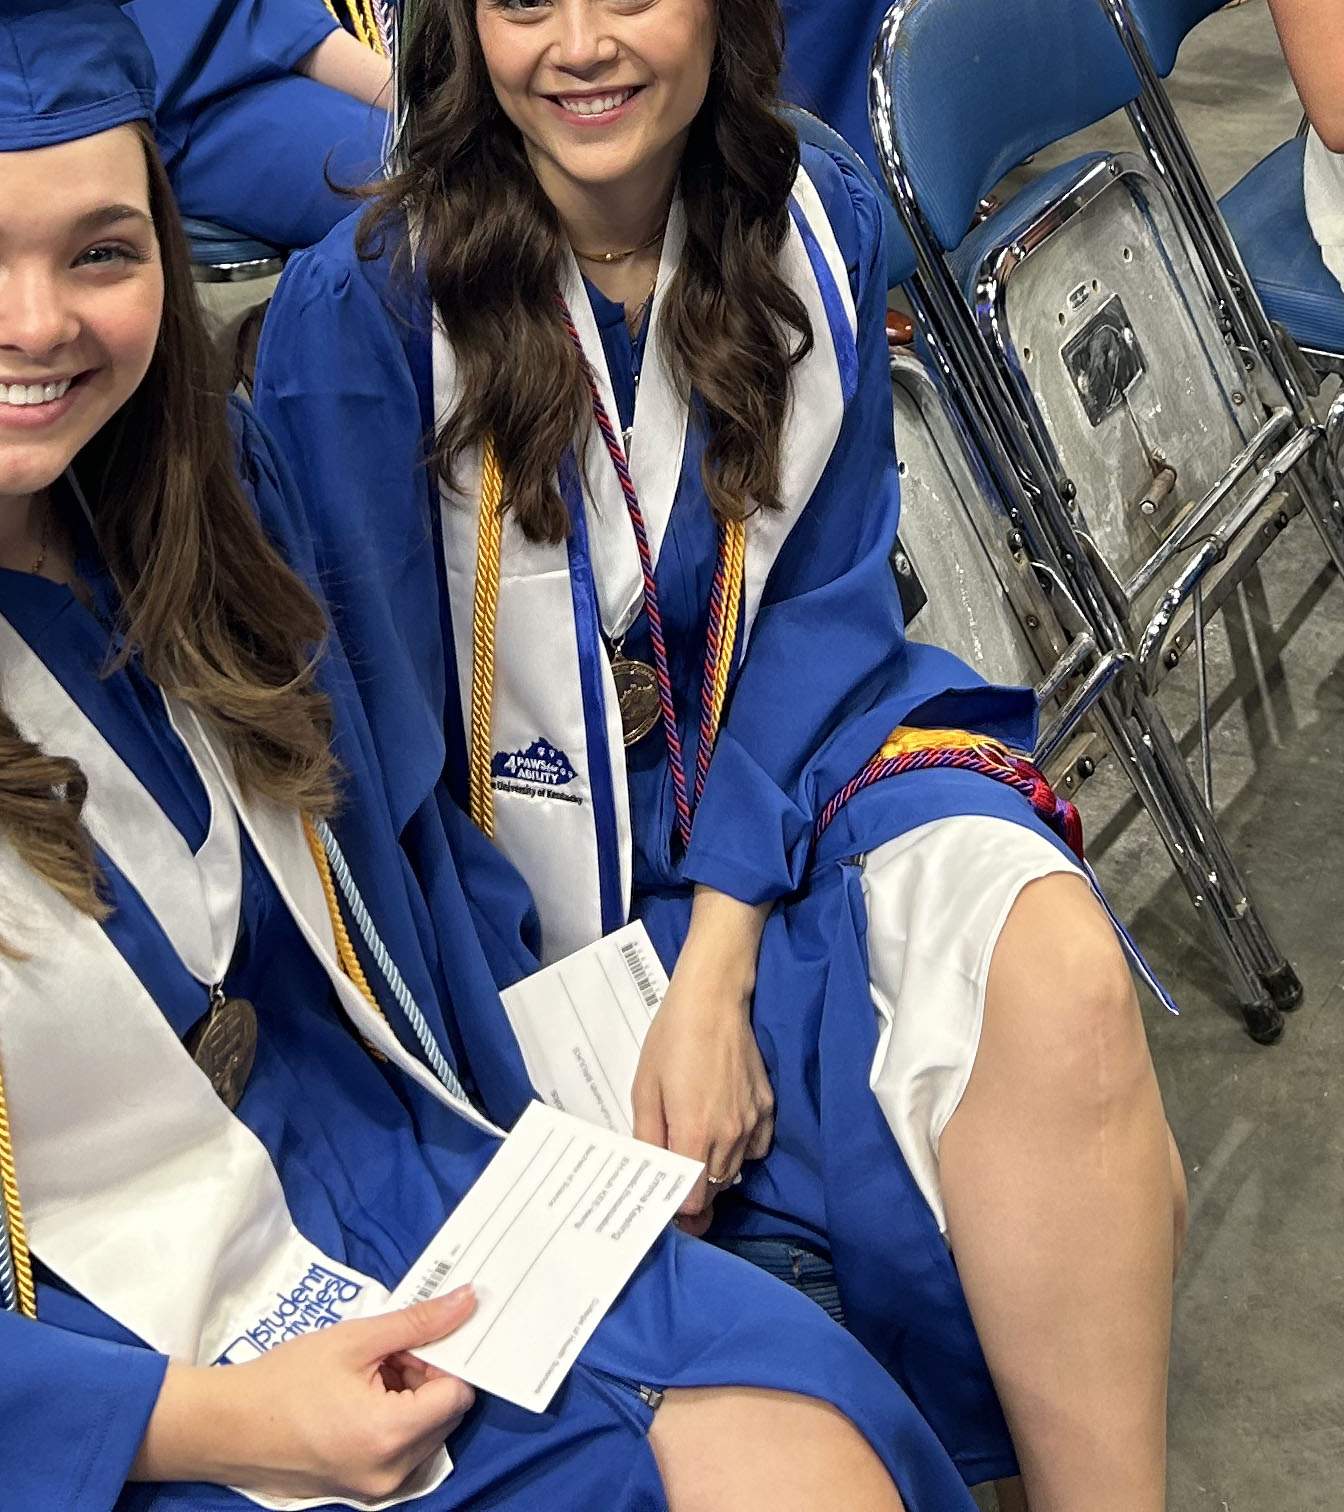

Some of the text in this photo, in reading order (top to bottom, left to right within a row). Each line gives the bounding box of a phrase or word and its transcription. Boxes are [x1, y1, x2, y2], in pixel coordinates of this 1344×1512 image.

[504, 755, 517, 774] 4
[517, 756, 546, 770] PAWS
[517, 767, 559, 784] AGILITY
[497, 781, 536, 798] University
[537, 787, 546, 798] of
[639, 1171, 666, 1203] Emma
[250, 1264, 325, 1346] student
[273, 1278, 342, 1346] ctivities
